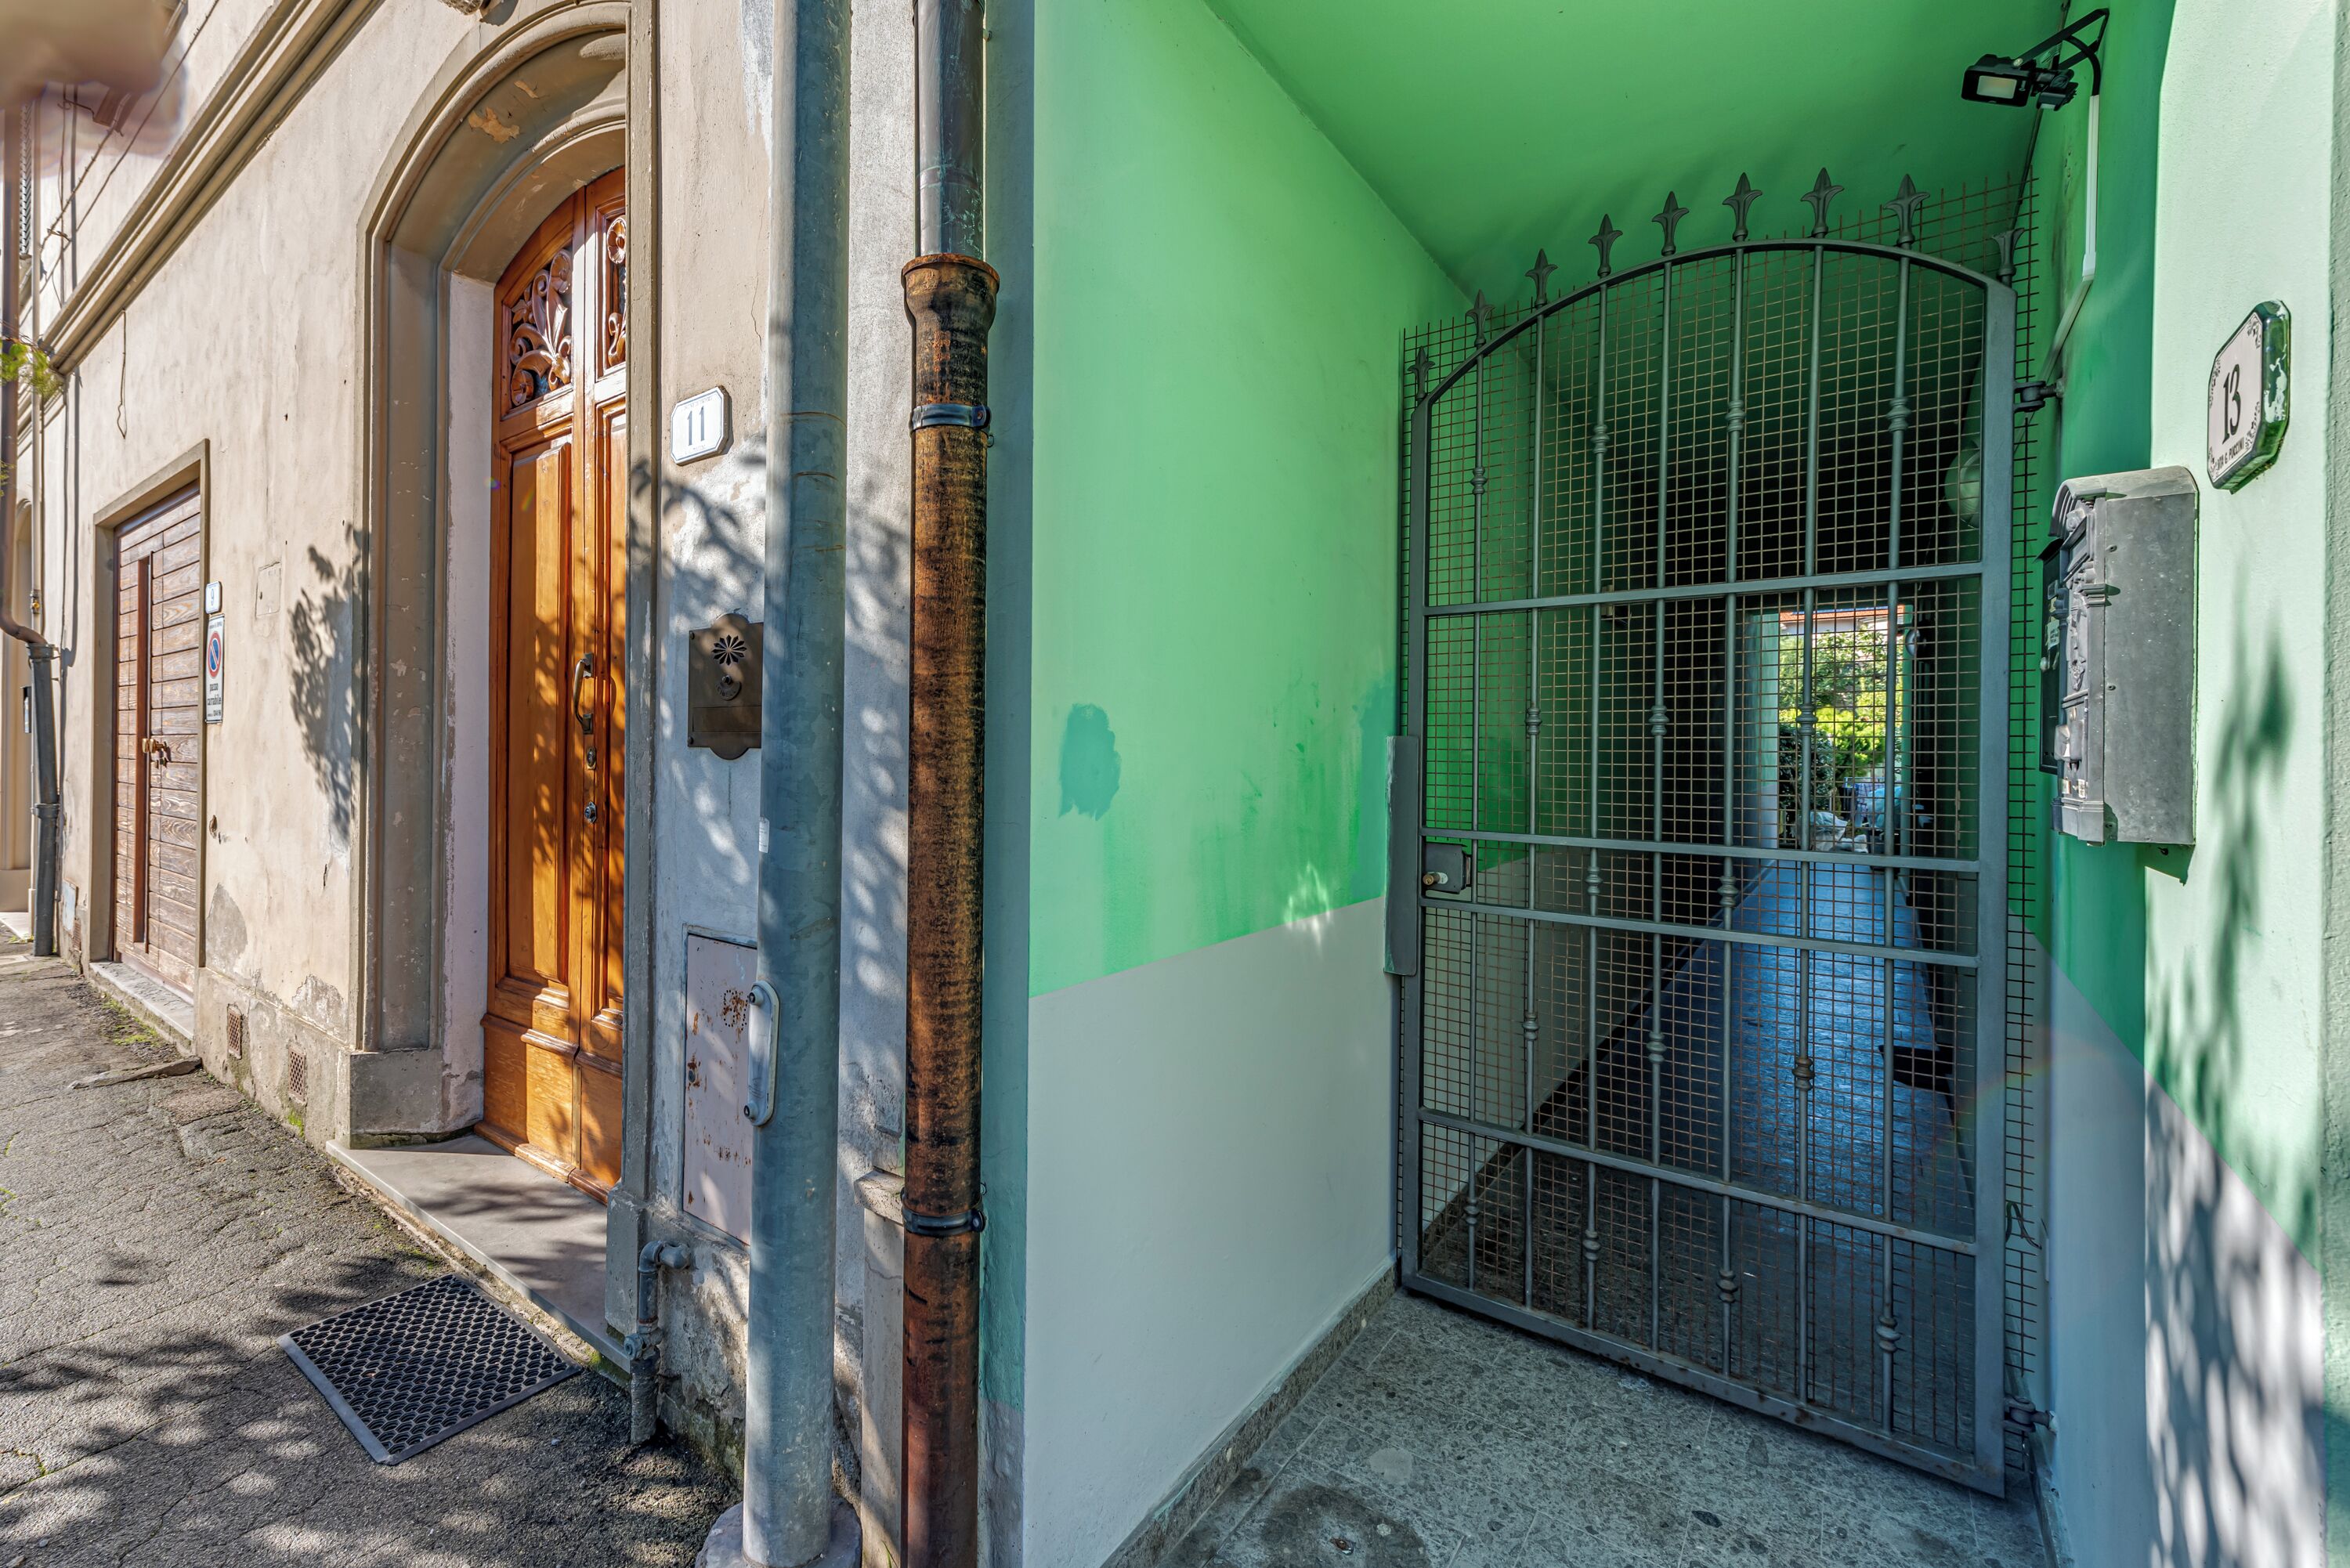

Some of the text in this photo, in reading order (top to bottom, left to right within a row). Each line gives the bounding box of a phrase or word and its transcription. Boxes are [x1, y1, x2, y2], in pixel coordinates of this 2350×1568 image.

[2222, 364, 2241, 445] 13
[687, 405, 705, 446] 11
[2229, 435, 2244, 461] PUCCINI
[211, 589, 215, 606] 9
